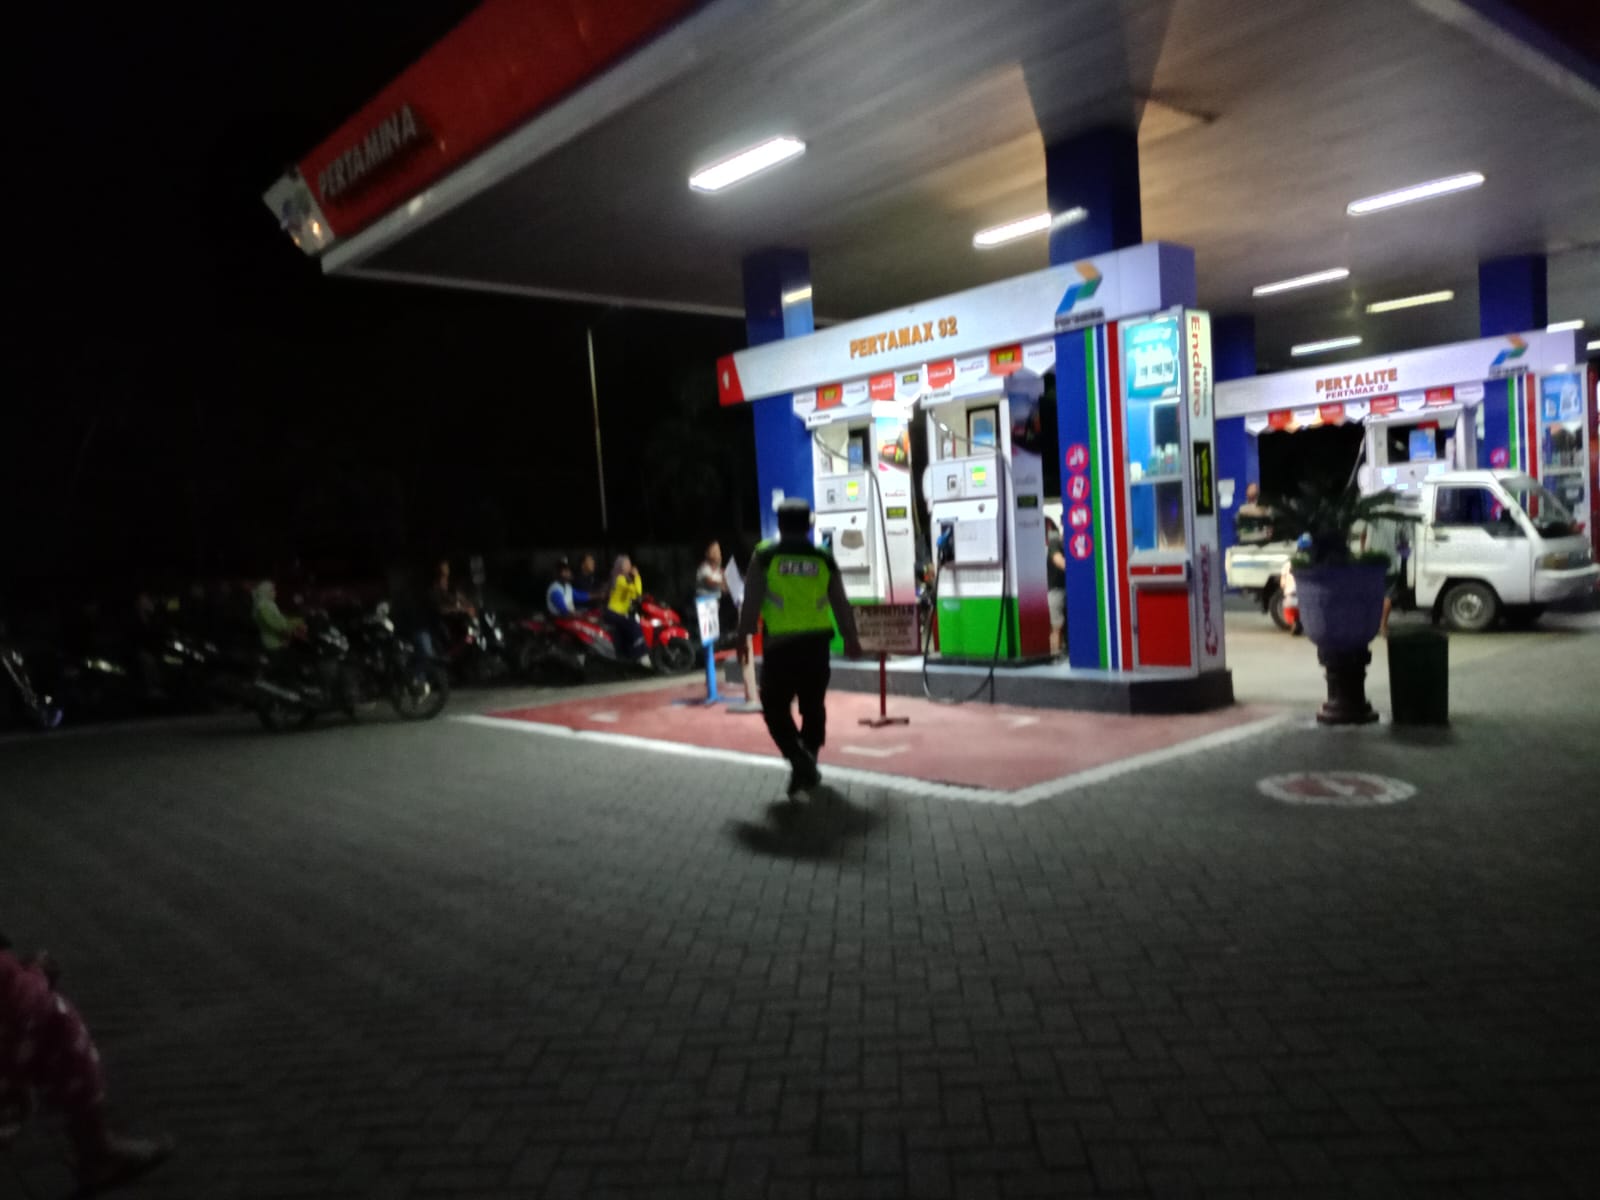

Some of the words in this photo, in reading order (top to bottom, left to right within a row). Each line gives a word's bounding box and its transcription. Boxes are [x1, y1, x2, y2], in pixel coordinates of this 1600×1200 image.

[318, 102, 417, 203] PERTAMINA
[850, 321, 934, 360] PERTAMAX
[938, 315, 958, 338] 92
[1191, 314, 1203, 417] Enduro
[1315, 367, 1398, 393] PERTALITE
[1326, 386, 1375, 400] PERTAMAX
